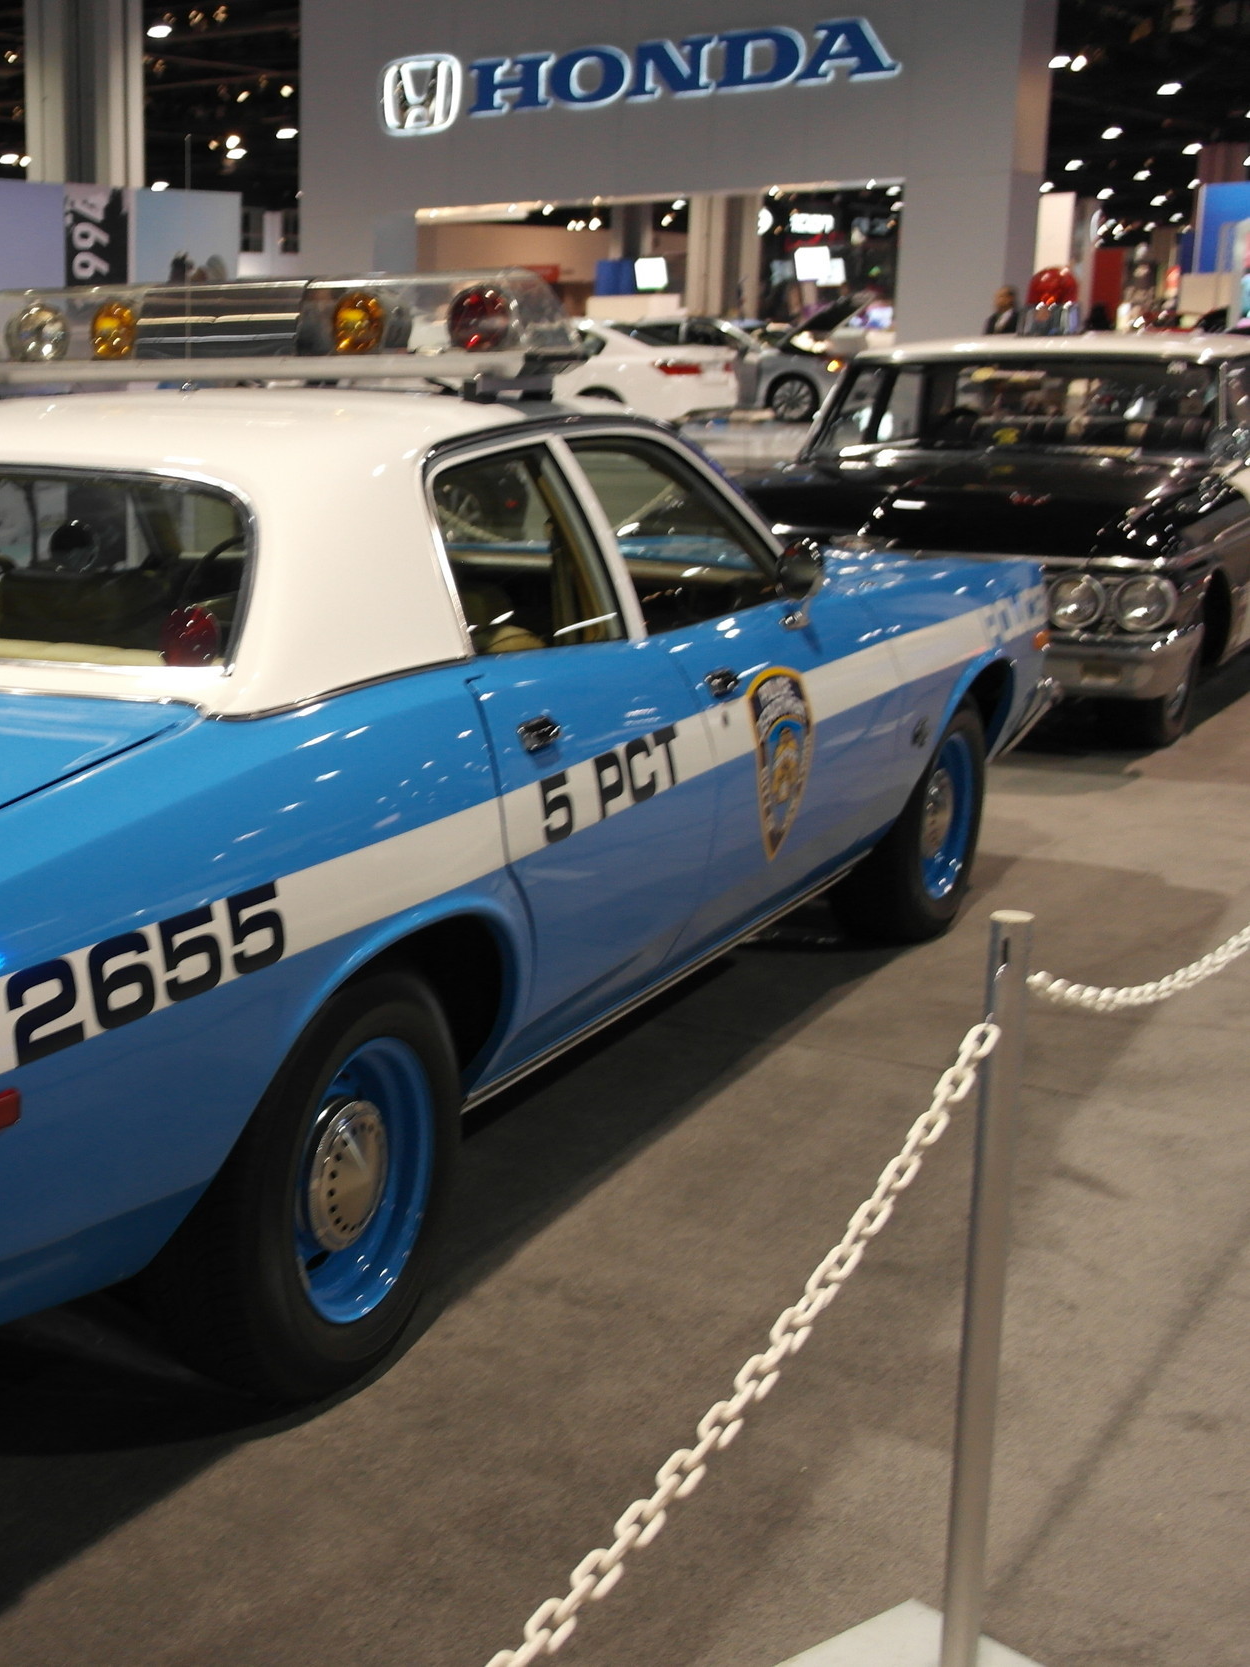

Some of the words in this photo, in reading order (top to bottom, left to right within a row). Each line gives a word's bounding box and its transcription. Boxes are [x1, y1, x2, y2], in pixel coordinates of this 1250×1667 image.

[468, 16, 903, 118] HONDA
[540, 771, 575, 843] 5
[594, 724, 677, 819] PCT
[6, 881, 286, 1067] 2655
